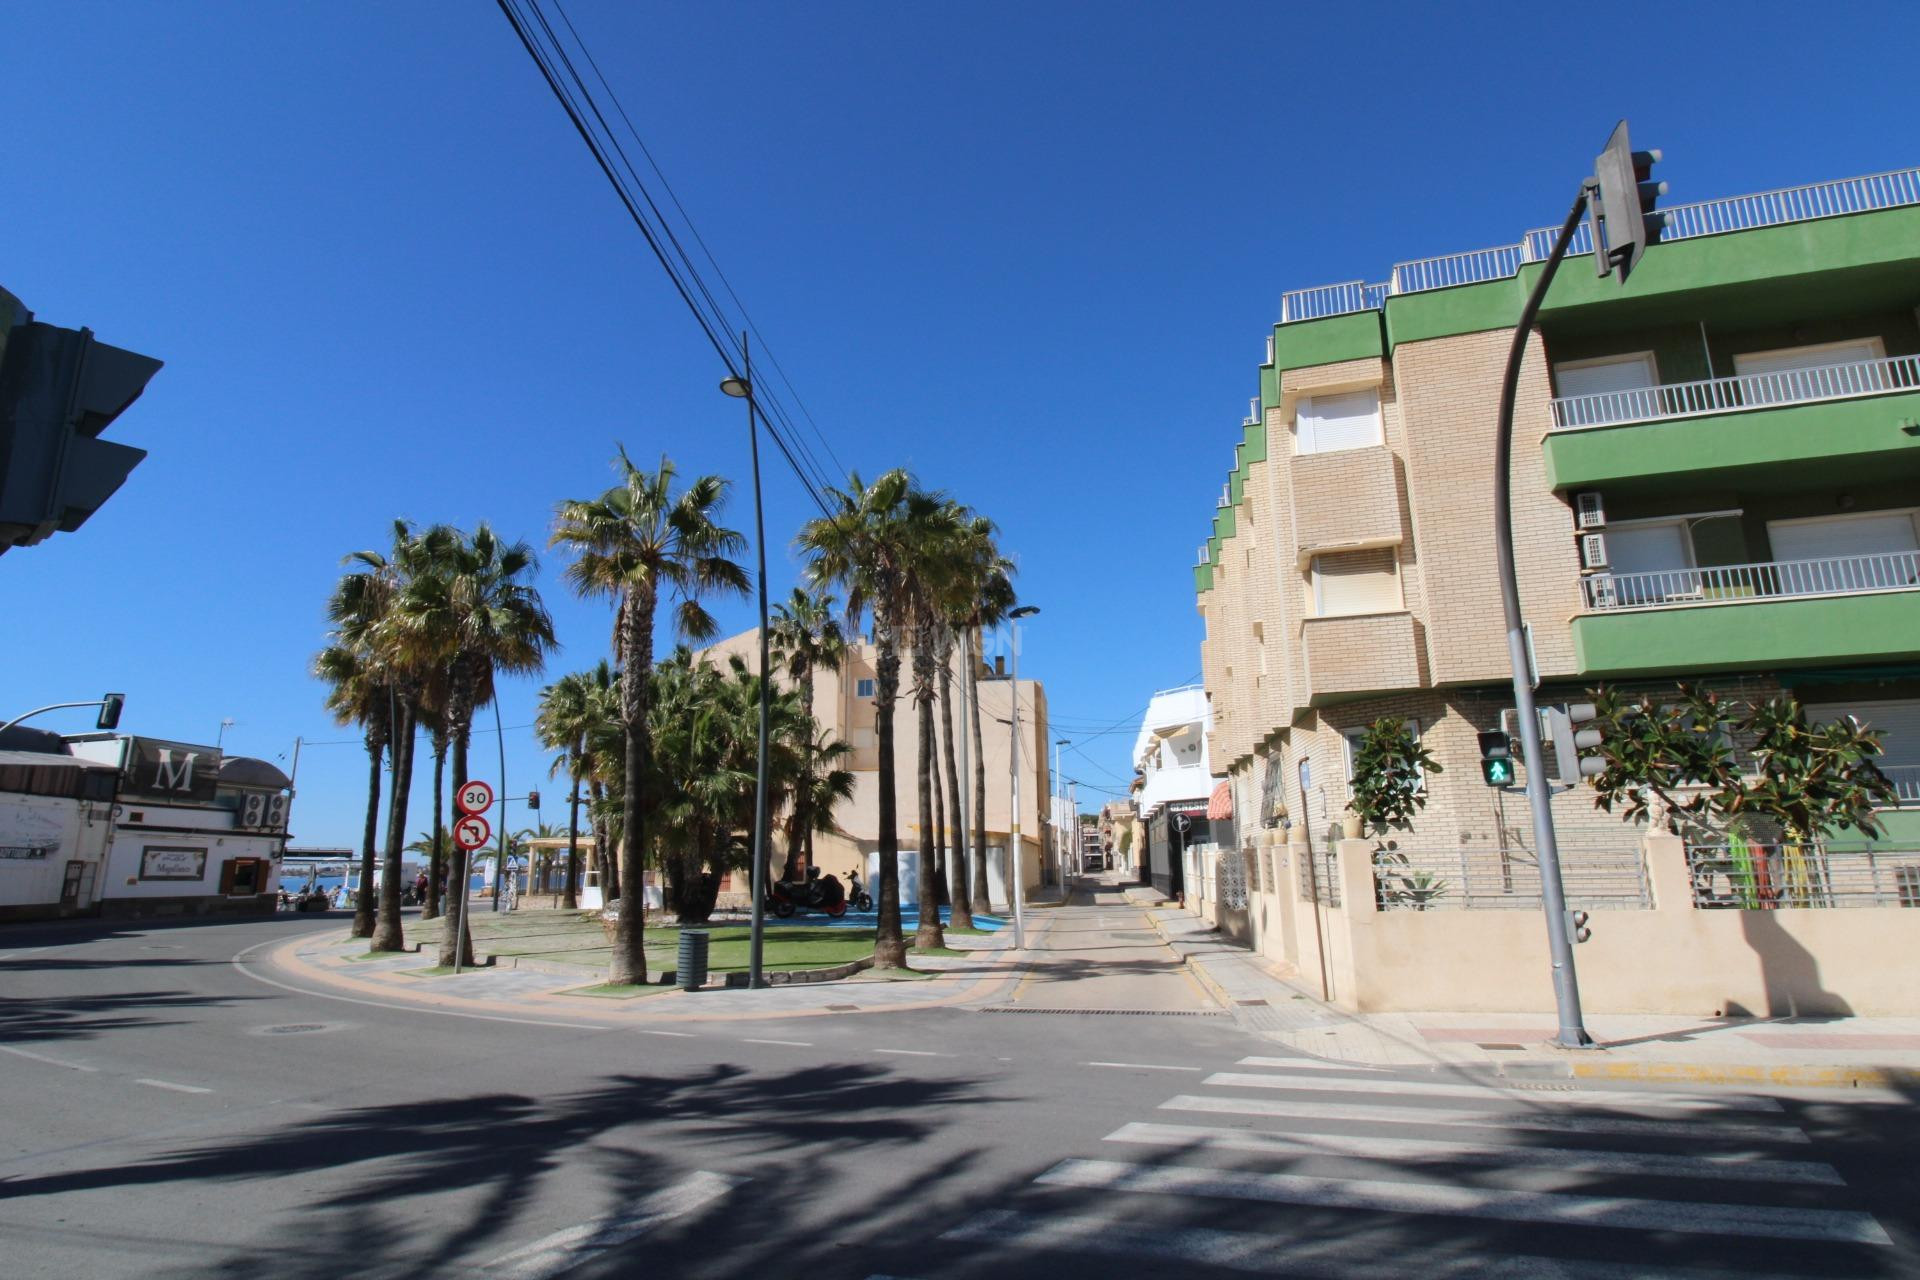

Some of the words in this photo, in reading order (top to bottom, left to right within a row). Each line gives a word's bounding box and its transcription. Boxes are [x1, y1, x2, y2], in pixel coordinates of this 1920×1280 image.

[151, 748, 200, 792] M
[466, 792, 486, 804] 30
[1170, 801, 1209, 812] GENESIS
